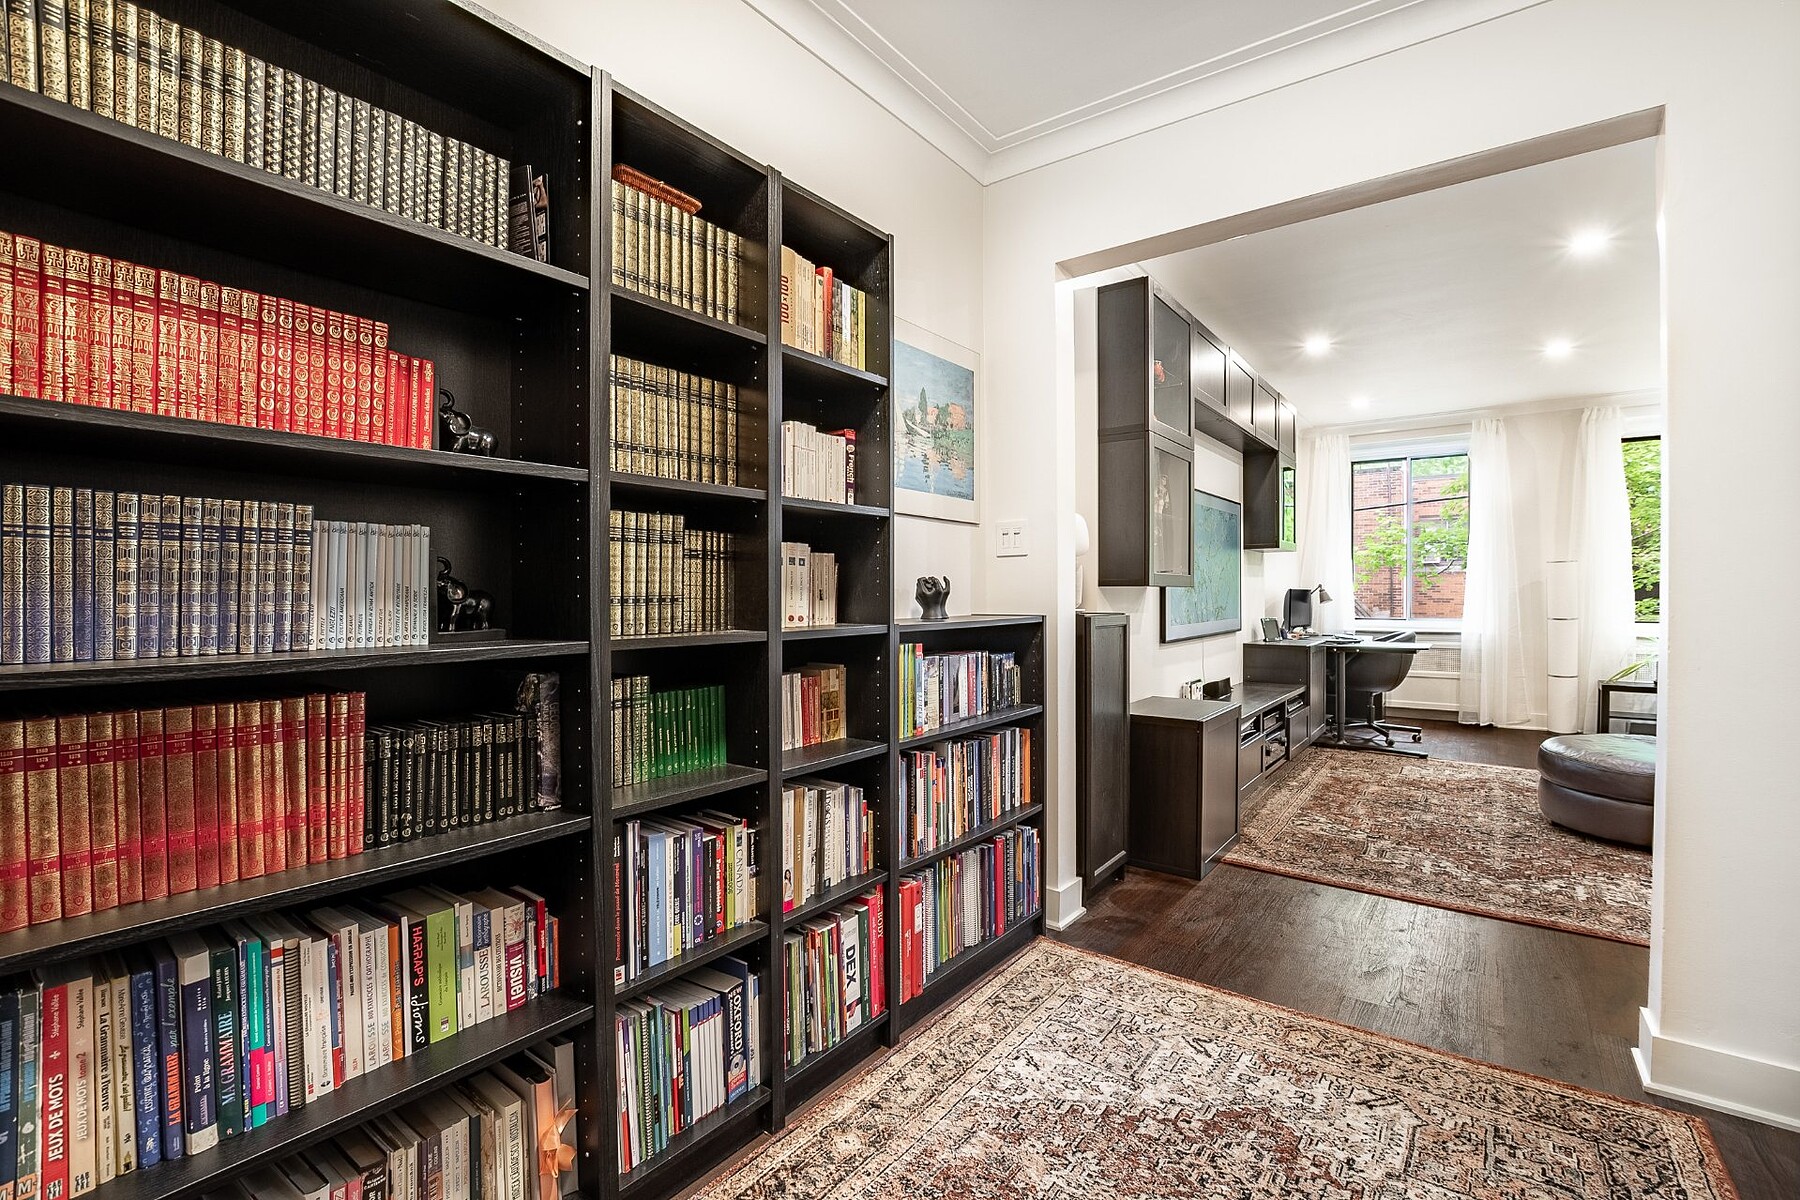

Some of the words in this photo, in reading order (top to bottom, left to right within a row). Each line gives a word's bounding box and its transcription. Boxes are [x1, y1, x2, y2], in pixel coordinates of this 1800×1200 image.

[736, 849, 744, 895] CANADA
[412, 926, 424, 986] HARRAP'S
[510, 954, 525, 1000] visuel
[846, 944, 856, 988] DEX
[479, 949, 490, 1010] LAROUSSE
[100, 1012, 110, 1022] La
[410, 994, 428, 1044] idioms
[733, 994, 743, 1051] OXFORD
[100, 1021, 110, 1072] Grammaire
[218, 1010, 234, 1082] GRAMMAIRE
[48, 1073, 64, 1109] MOTS
[76, 1079, 88, 1105] MOTS
[166, 1052, 182, 1112] GRAMMAIRE
[220, 1086, 236, 1106] MA
[48, 1110, 64, 1127] DE
[76, 1105, 88, 1117] DE
[76, 1117, 88, 1140] JEUX
[168, 1112, 182, 1127] LA
[48, 1128, 64, 1161] JEUX
